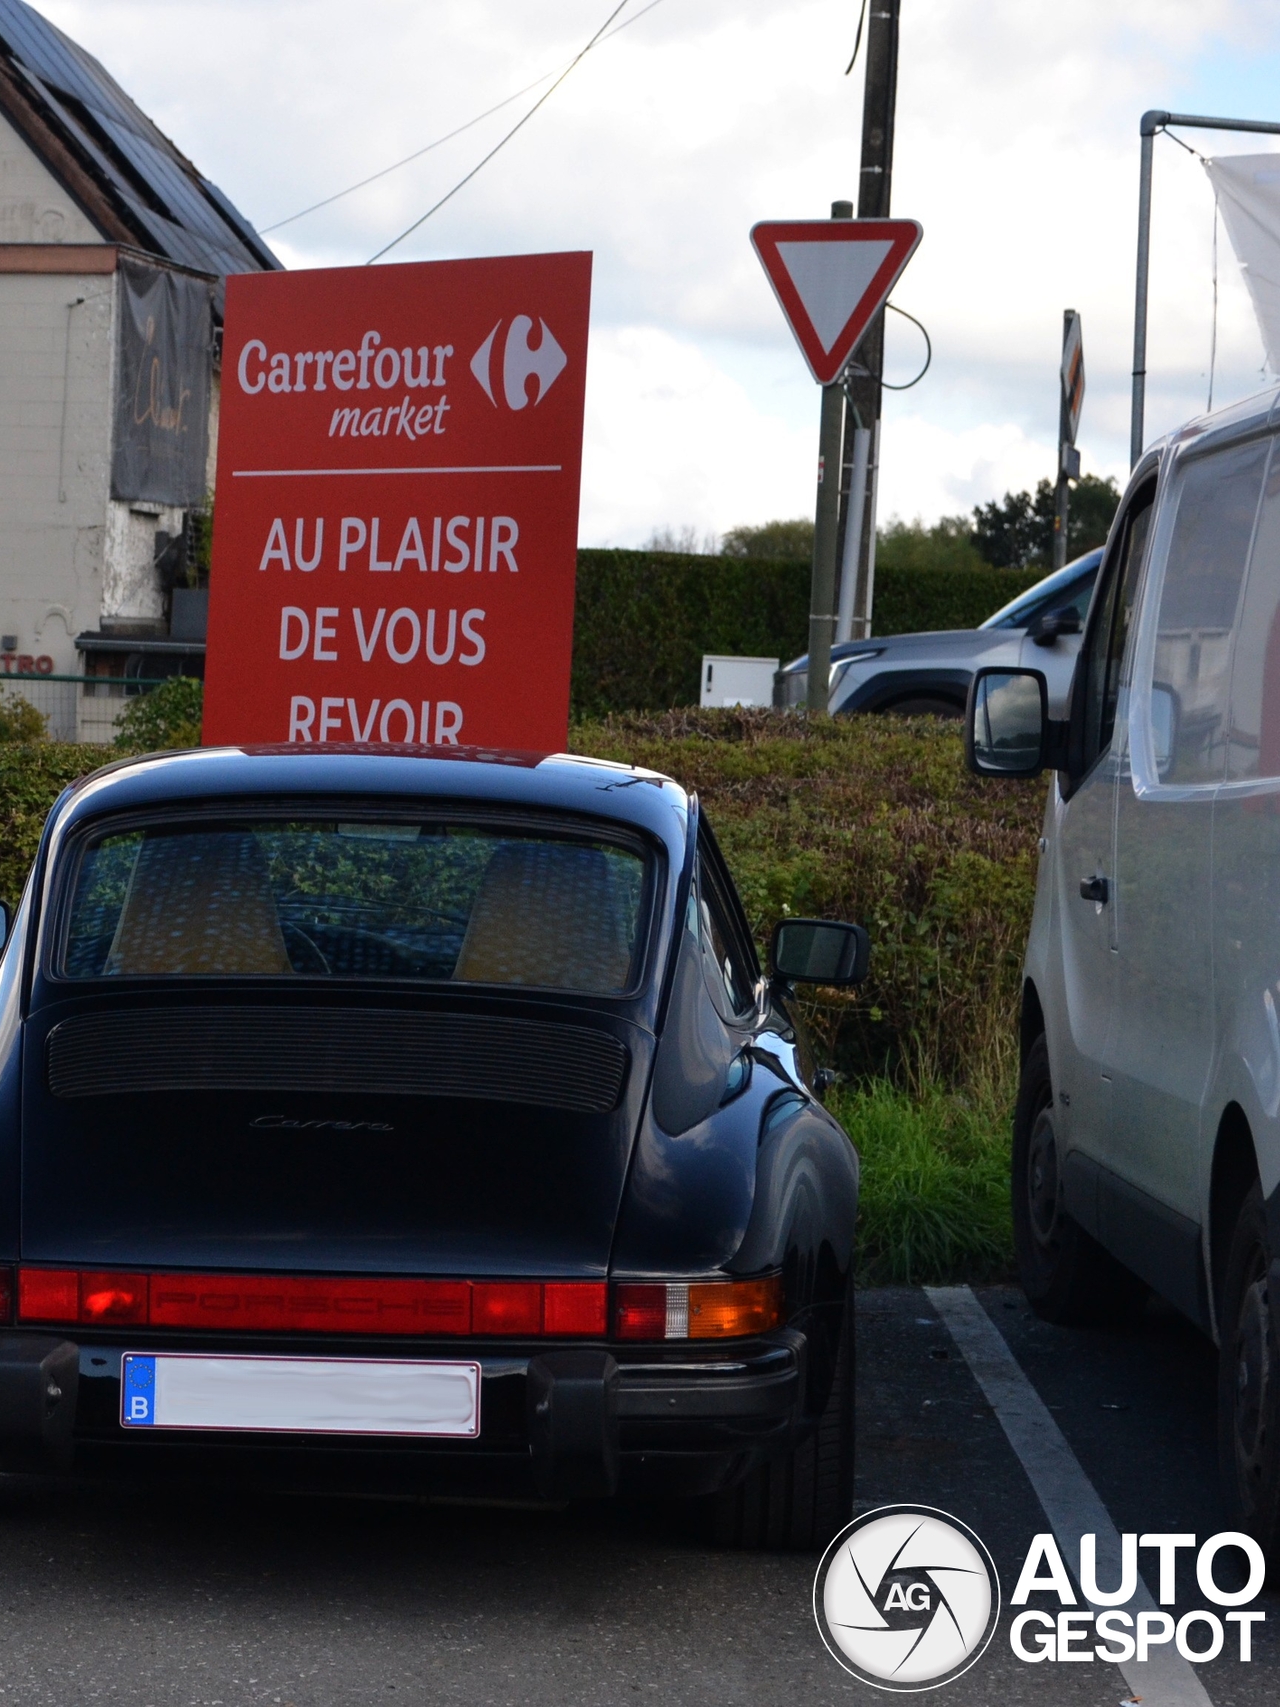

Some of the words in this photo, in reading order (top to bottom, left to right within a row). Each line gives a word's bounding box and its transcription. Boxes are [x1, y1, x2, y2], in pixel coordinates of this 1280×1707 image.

[238, 330, 454, 394] Carrefour
[328, 395, 450, 441] market
[259, 517, 324, 572] AU
[338, 516, 519, 573] PLAISIR
[279, 606, 339, 661] DE
[352, 607, 486, 666] VOUS
[288, 695, 464, 745] REVOIR
[249, 1114, 394, 1131] Carrera
[155, 1289, 466, 1317] PORSCHE
[131, 1396, 149, 1420] B
